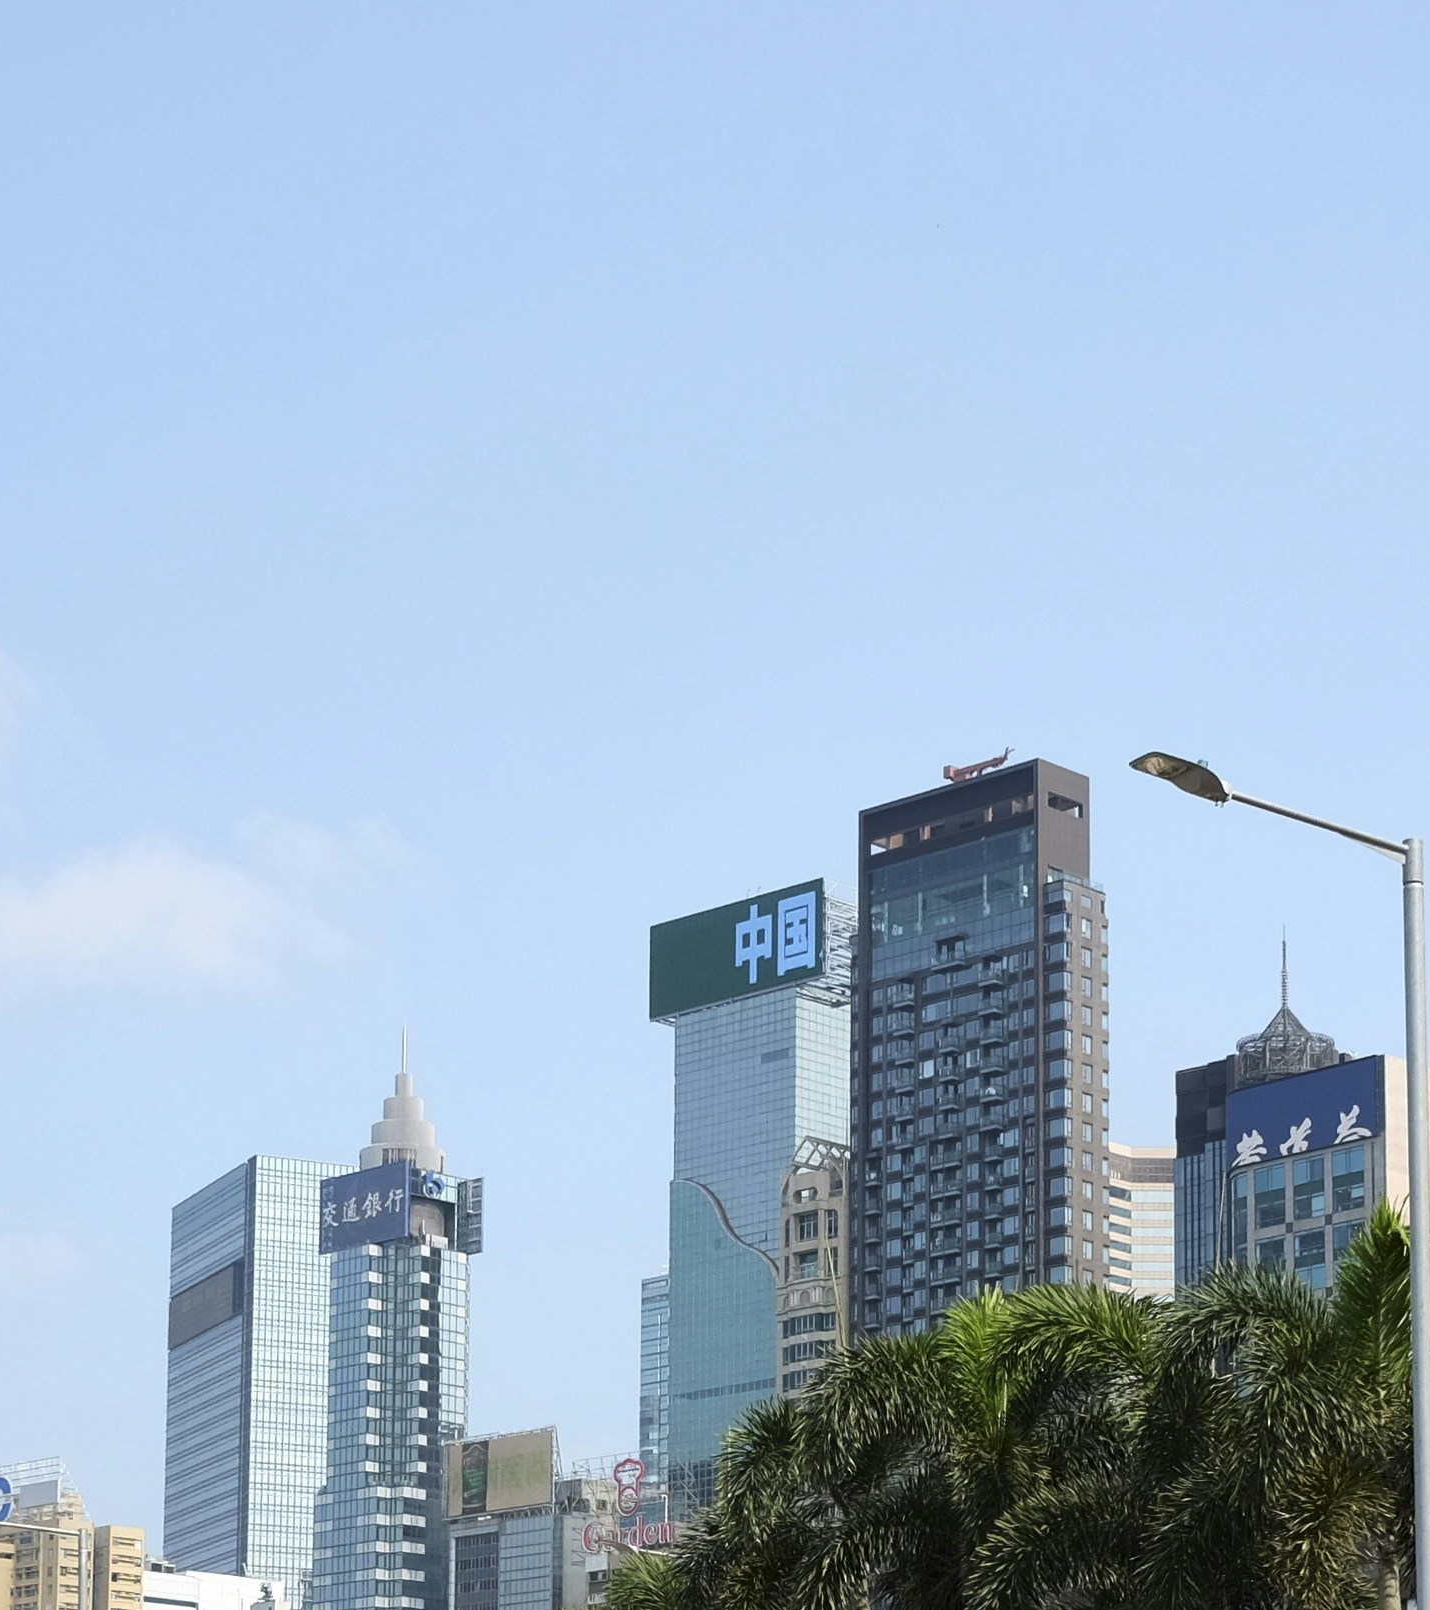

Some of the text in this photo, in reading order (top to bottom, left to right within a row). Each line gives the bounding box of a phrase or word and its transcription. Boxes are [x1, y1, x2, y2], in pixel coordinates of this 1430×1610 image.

[735, 890, 816, 985] 中国
[323, 1189, 404, 1227] 交通銀行
[582, 1516, 675, 1554] Garden
